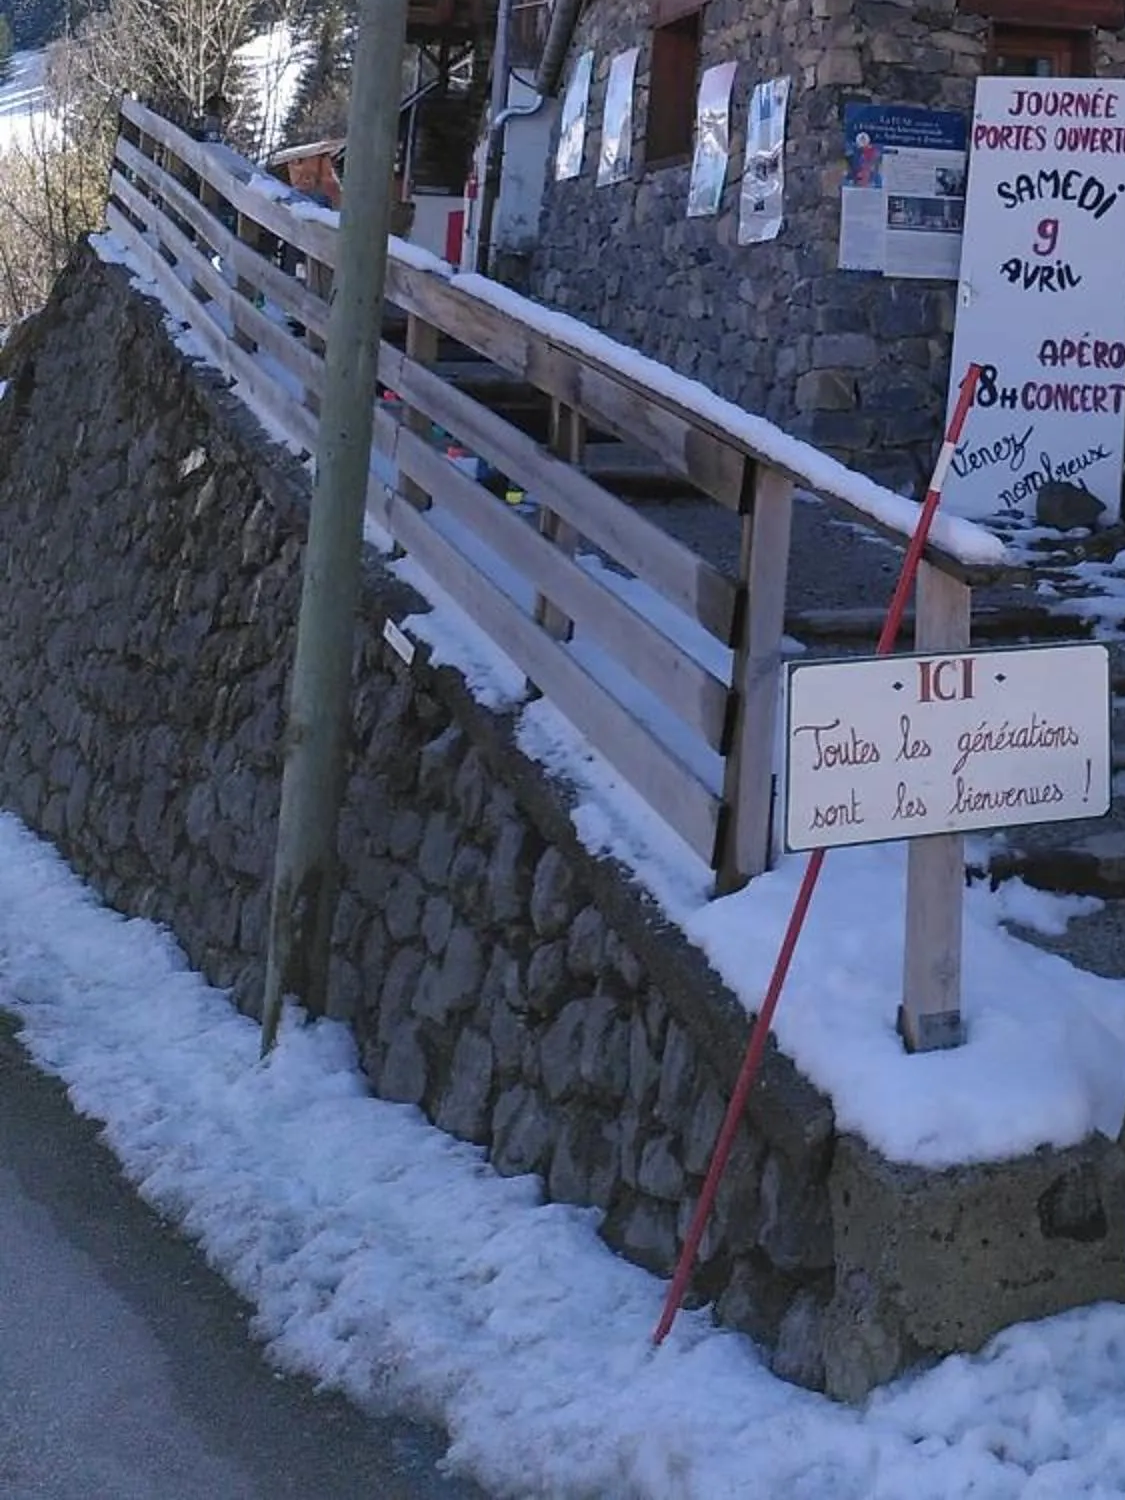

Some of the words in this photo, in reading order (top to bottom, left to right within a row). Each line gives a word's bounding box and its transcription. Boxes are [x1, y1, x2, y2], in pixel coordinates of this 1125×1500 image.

[1008, 88, 1119, 118] JOURNÉE
[974, 125, 1047, 151] PORTES
[1033, 218, 1059, 256] 9
[951, 426, 1034, 477] Venez
[998, 444, 1113, 509] nombreux
[916, 657, 977, 703] ICI
[794, 719, 881, 771] Toutes
[895, 714, 932, 762] les
[952, 711, 1080, 775] générations
[809, 788, 864, 831] sont
[891, 781, 928, 821] les
[949, 775, 1065, 815] bienvenues
